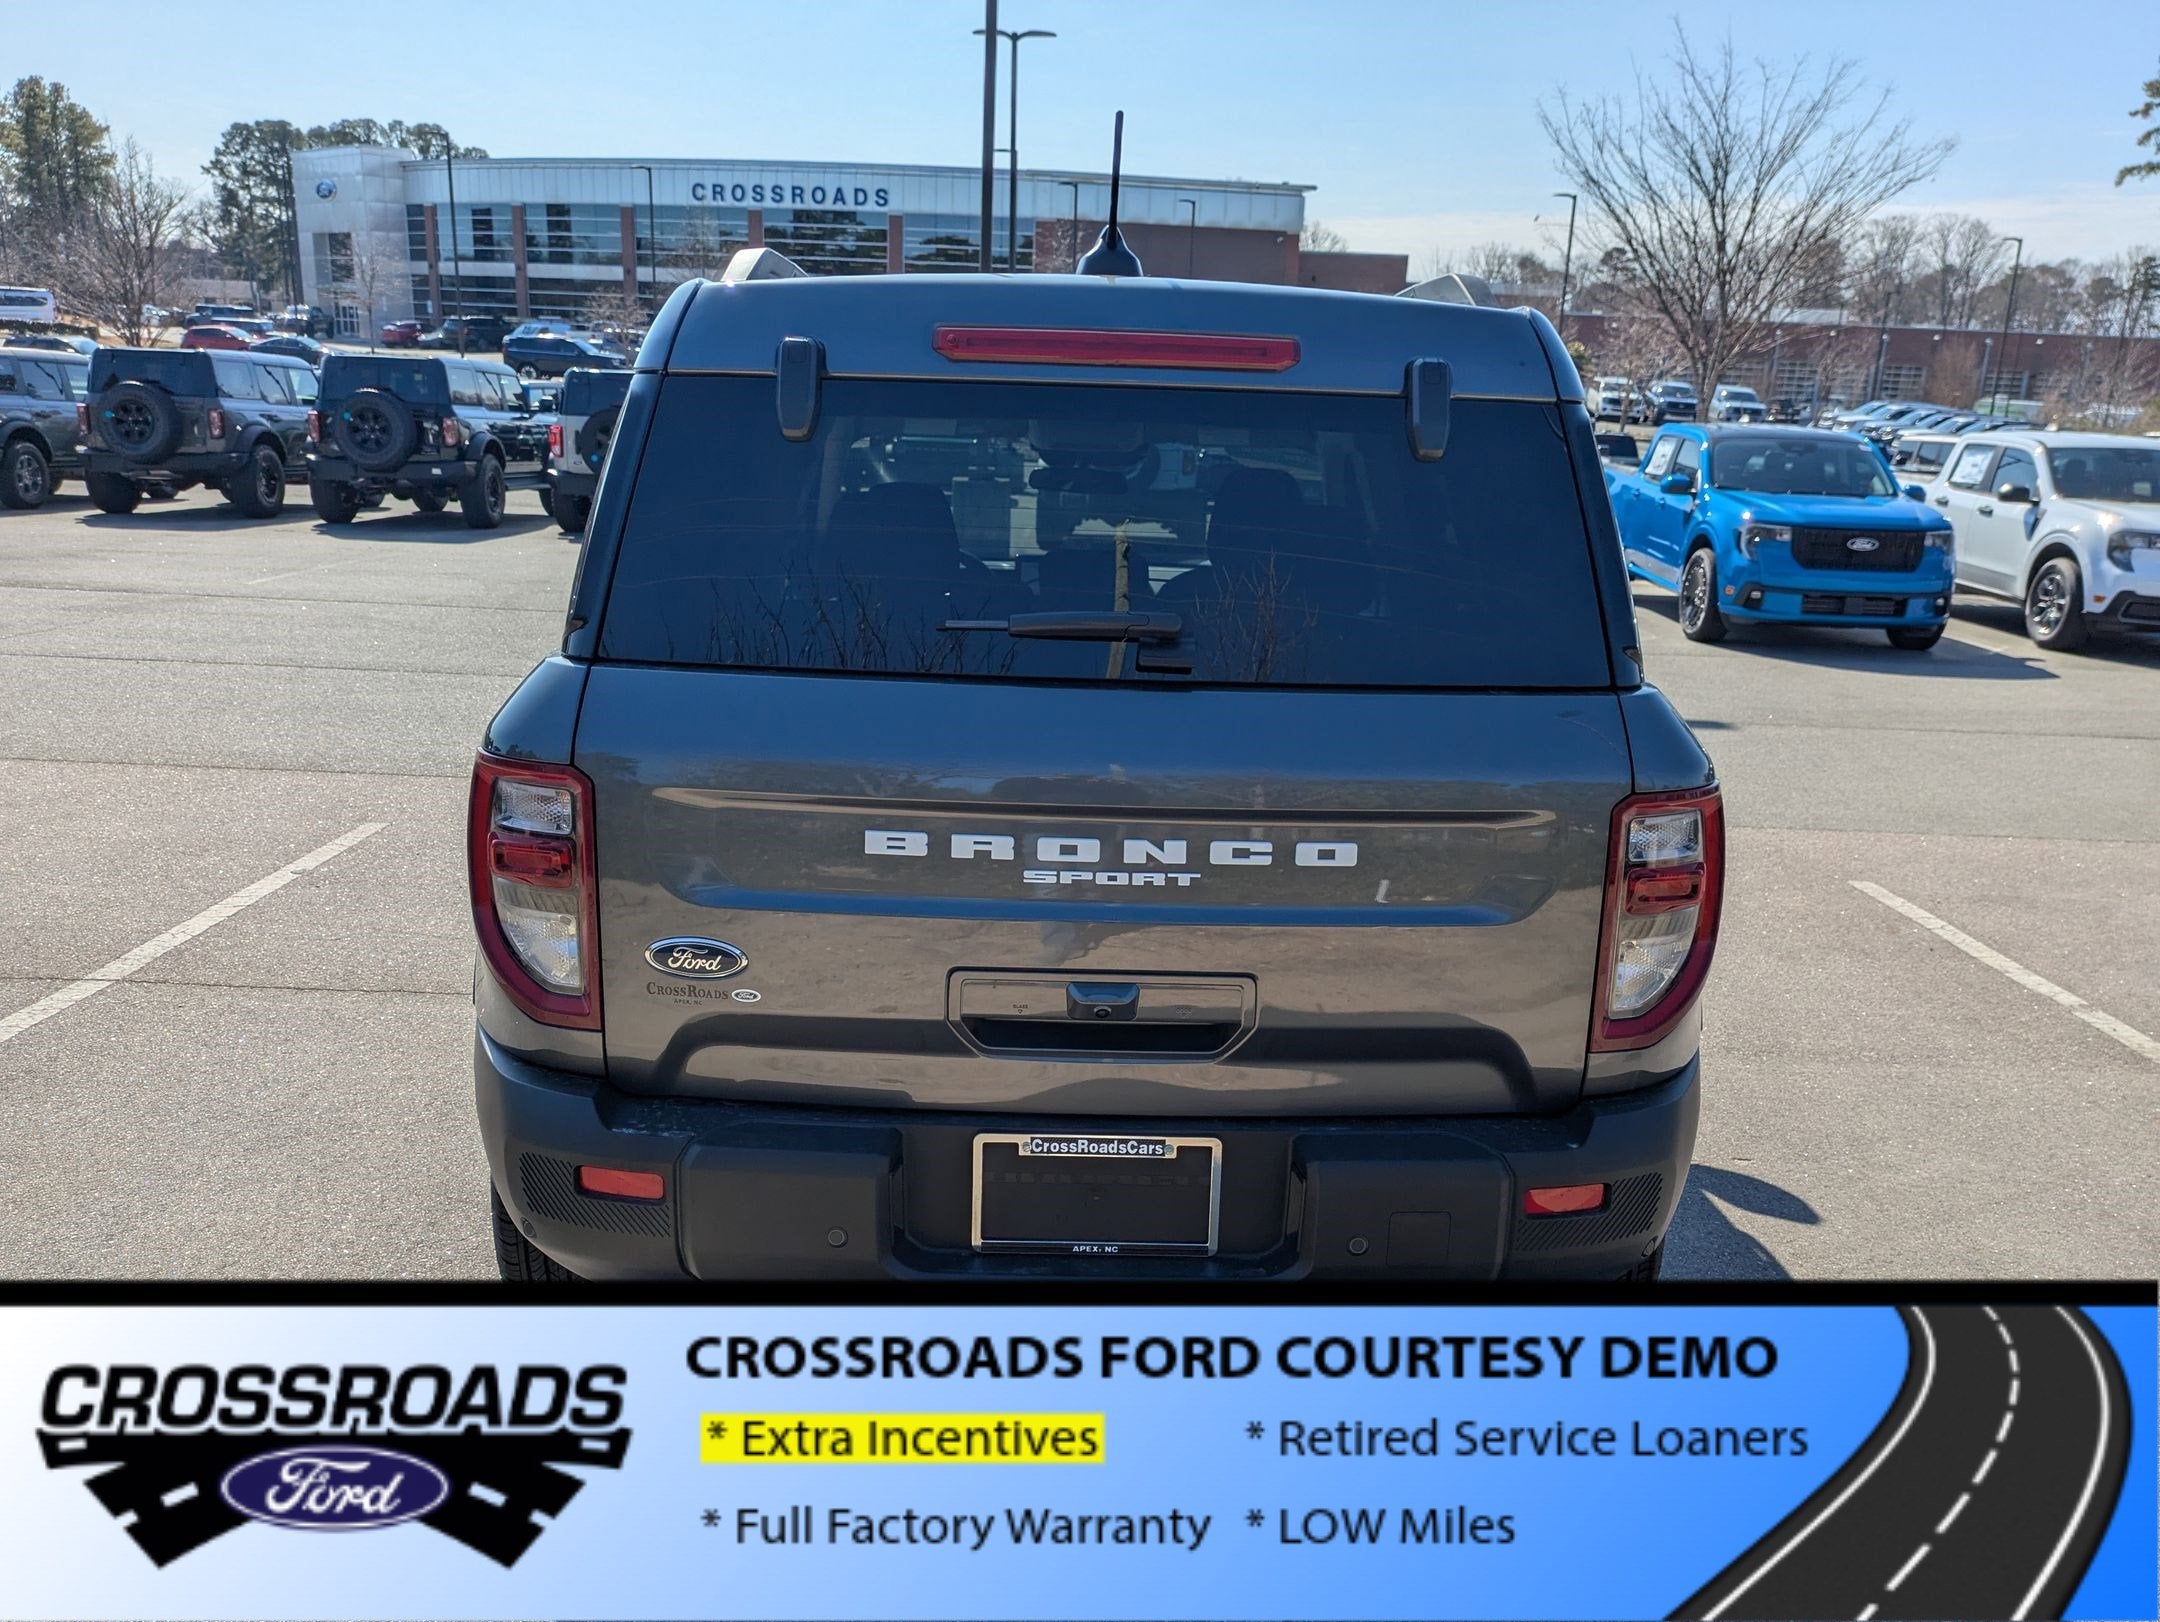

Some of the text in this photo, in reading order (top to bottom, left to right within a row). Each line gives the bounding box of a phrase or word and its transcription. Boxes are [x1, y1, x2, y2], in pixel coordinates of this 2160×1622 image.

[690, 182, 889, 207] CROSSROADS
[863, 829, 1358, 867] BRONCO
[1023, 870, 1201, 886] SPORT
[667, 946, 722, 971] Ford
[1031, 1138, 1164, 1155] CrossRoadsCars
